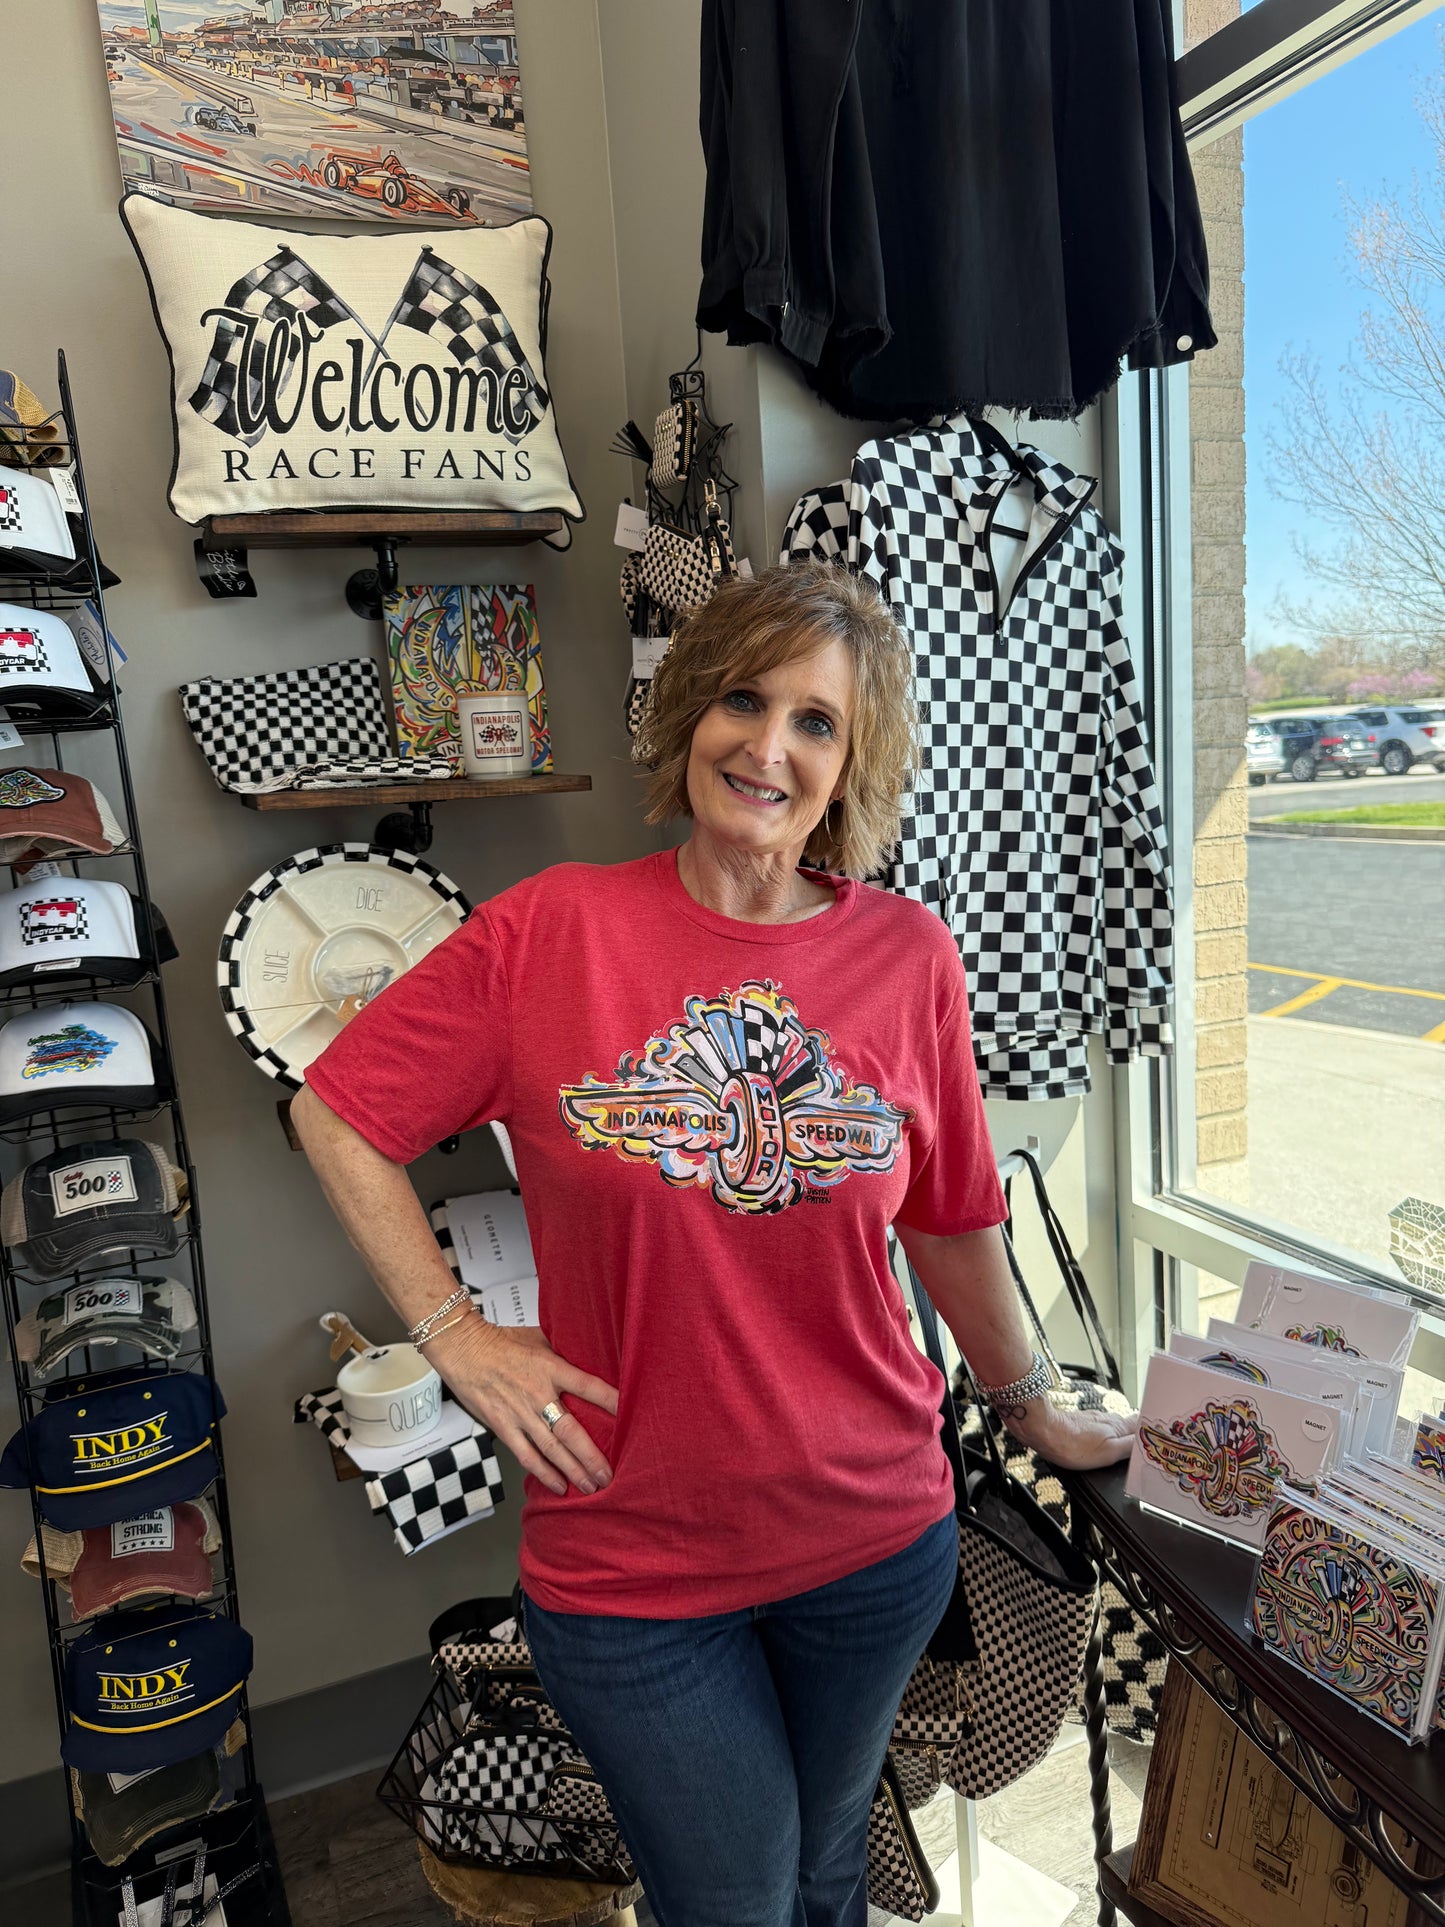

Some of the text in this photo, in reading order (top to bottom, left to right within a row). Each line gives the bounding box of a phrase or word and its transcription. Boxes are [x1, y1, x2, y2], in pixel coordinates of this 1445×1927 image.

[200, 307, 529, 434] Welcome
[222, 448, 532, 482] RACE FANS
[224, 549, 240, 581] ittle
[413, 620, 453, 707] INDIANAPOLIS
[473, 715, 520, 724] INDIANAPOLIS
[356, 887, 384, 912] DICE
[31, 927, 64, 937] INDYCAR
[263, 949, 290, 983] SLICE
[607, 1111, 727, 1131] INDIANAPOLIS
[755, 1087, 779, 1177] MOTOR
[66, 1176, 106, 1199] 500
[806, 1188, 830, 1196] JUSTIN
[484, 1214, 503, 1262] GEOMETRY
[75, 1293, 113, 1312] 500
[510, 1285, 526, 1326] GEOMETR
[1366, 1379, 1388, 1389] MAGNET
[73, 1416, 167, 1460] INDY
[1305, 1420, 1327, 1431] MAGNET
[90, 1445, 160, 1469] Back Home Again
[1161, 1447, 1214, 1473] INDIANAPOLIS
[1221, 1455, 1237, 1500] MOTOR
[1241, 1477, 1272, 1495] SPEEDW
[124, 1524, 163, 1538] STRONG
[1278, 1589, 1328, 1626] INDIANAPOLIS
[1393, 1577, 1428, 1656] FANS
[1335, 1611, 1351, 1658] MOTOR
[1356, 1637, 1399, 1665] SPEEDWAY
[99, 1663, 190, 1699] INDY
[110, 1694, 179, 1710] Back Home Again
